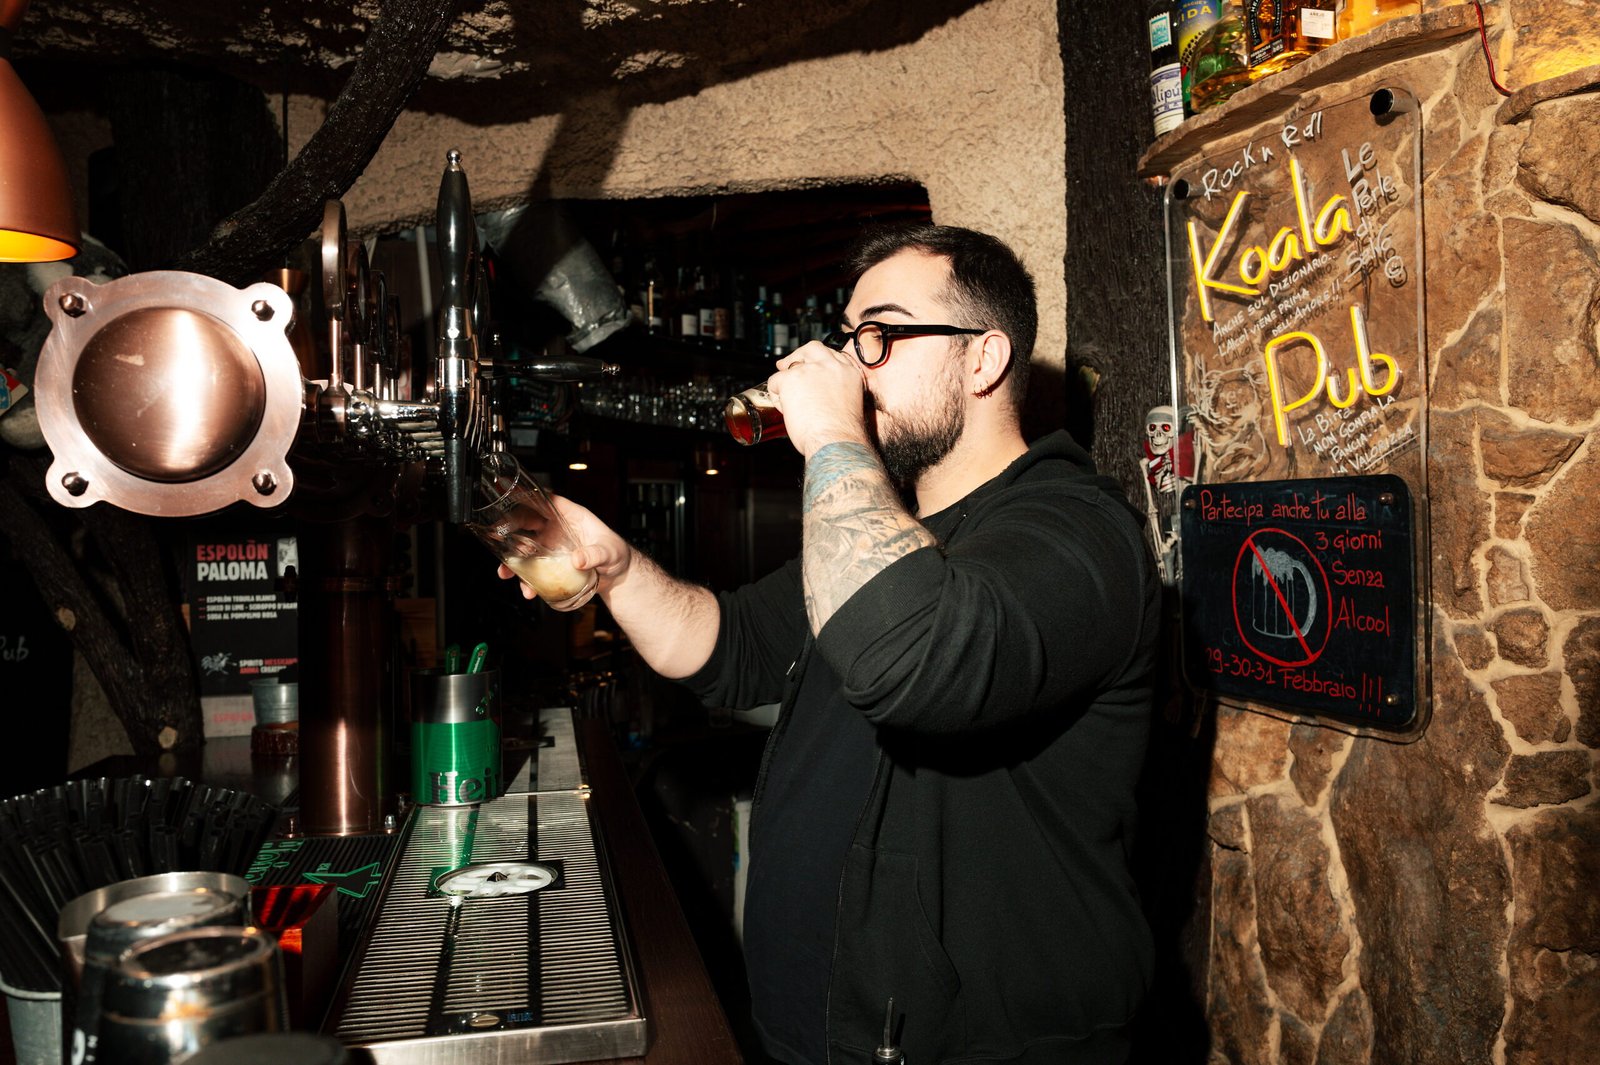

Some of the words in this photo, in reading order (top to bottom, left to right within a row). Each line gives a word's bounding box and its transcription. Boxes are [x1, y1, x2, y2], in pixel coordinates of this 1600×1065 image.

[1181, 5, 1212, 22] IDA
[1341, 142, 1375, 182] Le
[1352, 168, 1395, 216] Perle
[1187, 157, 1353, 322] Koala
[1247, 296, 1267, 317] SUL
[1277, 287, 1310, 315] PRIMA
[1265, 302, 1400, 446] Pub
[1313, 431, 1338, 456] NON
[1376, 395, 1396, 411] LA
[1201, 489, 1264, 527] Partecipa
[1271, 493, 1311, 519] anche
[1335, 492, 1367, 520] alla
[1315, 532, 1329, 550] 3
[1333, 529, 1383, 554] giorni
[197, 561, 269, 582] PALOMA
[1332, 561, 1385, 588] Senza
[1334, 596, 1390, 637] Alcool
[1277, 667, 1356, 700] Febbraio
